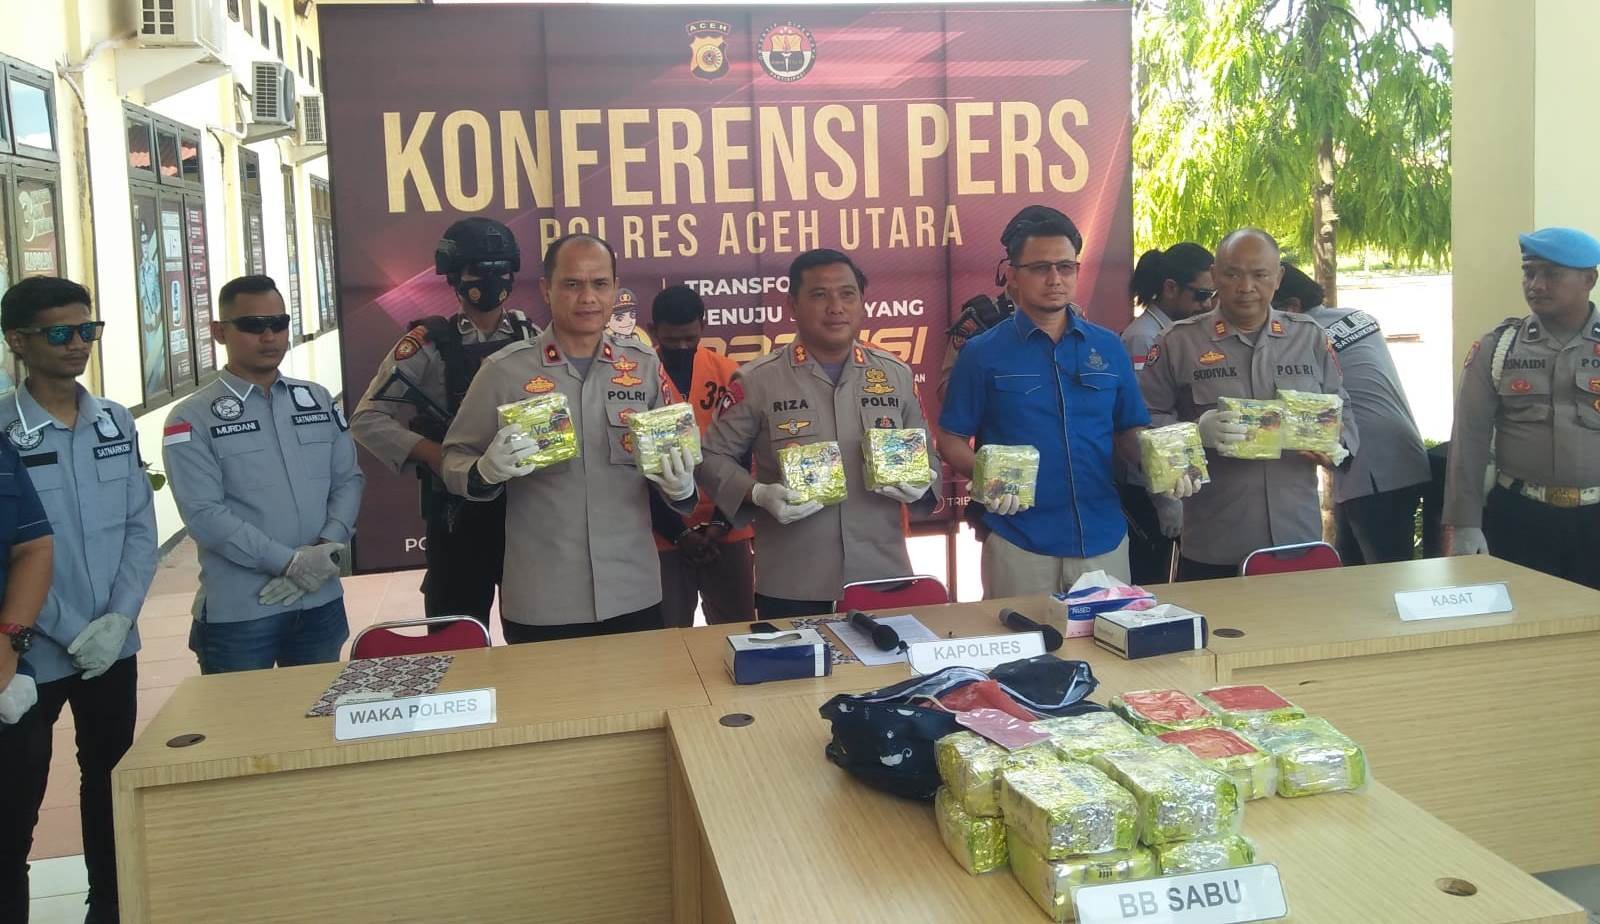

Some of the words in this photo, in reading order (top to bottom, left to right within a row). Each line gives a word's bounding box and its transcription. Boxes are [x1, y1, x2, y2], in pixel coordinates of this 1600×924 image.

[689, 23, 727, 32] ACEH
[383, 103, 879, 213] KONFERENSI
[907, 98, 1090, 196] PERS
[718, 209, 820, 256] ACEH
[839, 204, 963, 250] UTARA
[684, 275, 791, 296] TRANSFO
[703, 306, 783, 326] ENUJU
[864, 299, 924, 318] YANG
[1277, 364, 1314, 376] POLRI
[1581, 358, 1600, 369] PO
[914, 373, 926, 384] AN
[607, 390, 646, 402] POLRI
[773, 399, 809, 412] RIZA
[861, 396, 899, 408] POLRI
[215, 422, 257, 435] MURDANI
[96, 443, 131, 458] SATNARKOB
[405, 536, 427, 552] PO
[1430, 592, 1473, 607] KASAT
[933, 640, 1021, 661] KAPOLRES
[350, 705, 403, 725] WAKA
[408, 697, 478, 719] POLRES
[1118, 890, 1159, 919] BB
[1167, 879, 1243, 912] SABU
